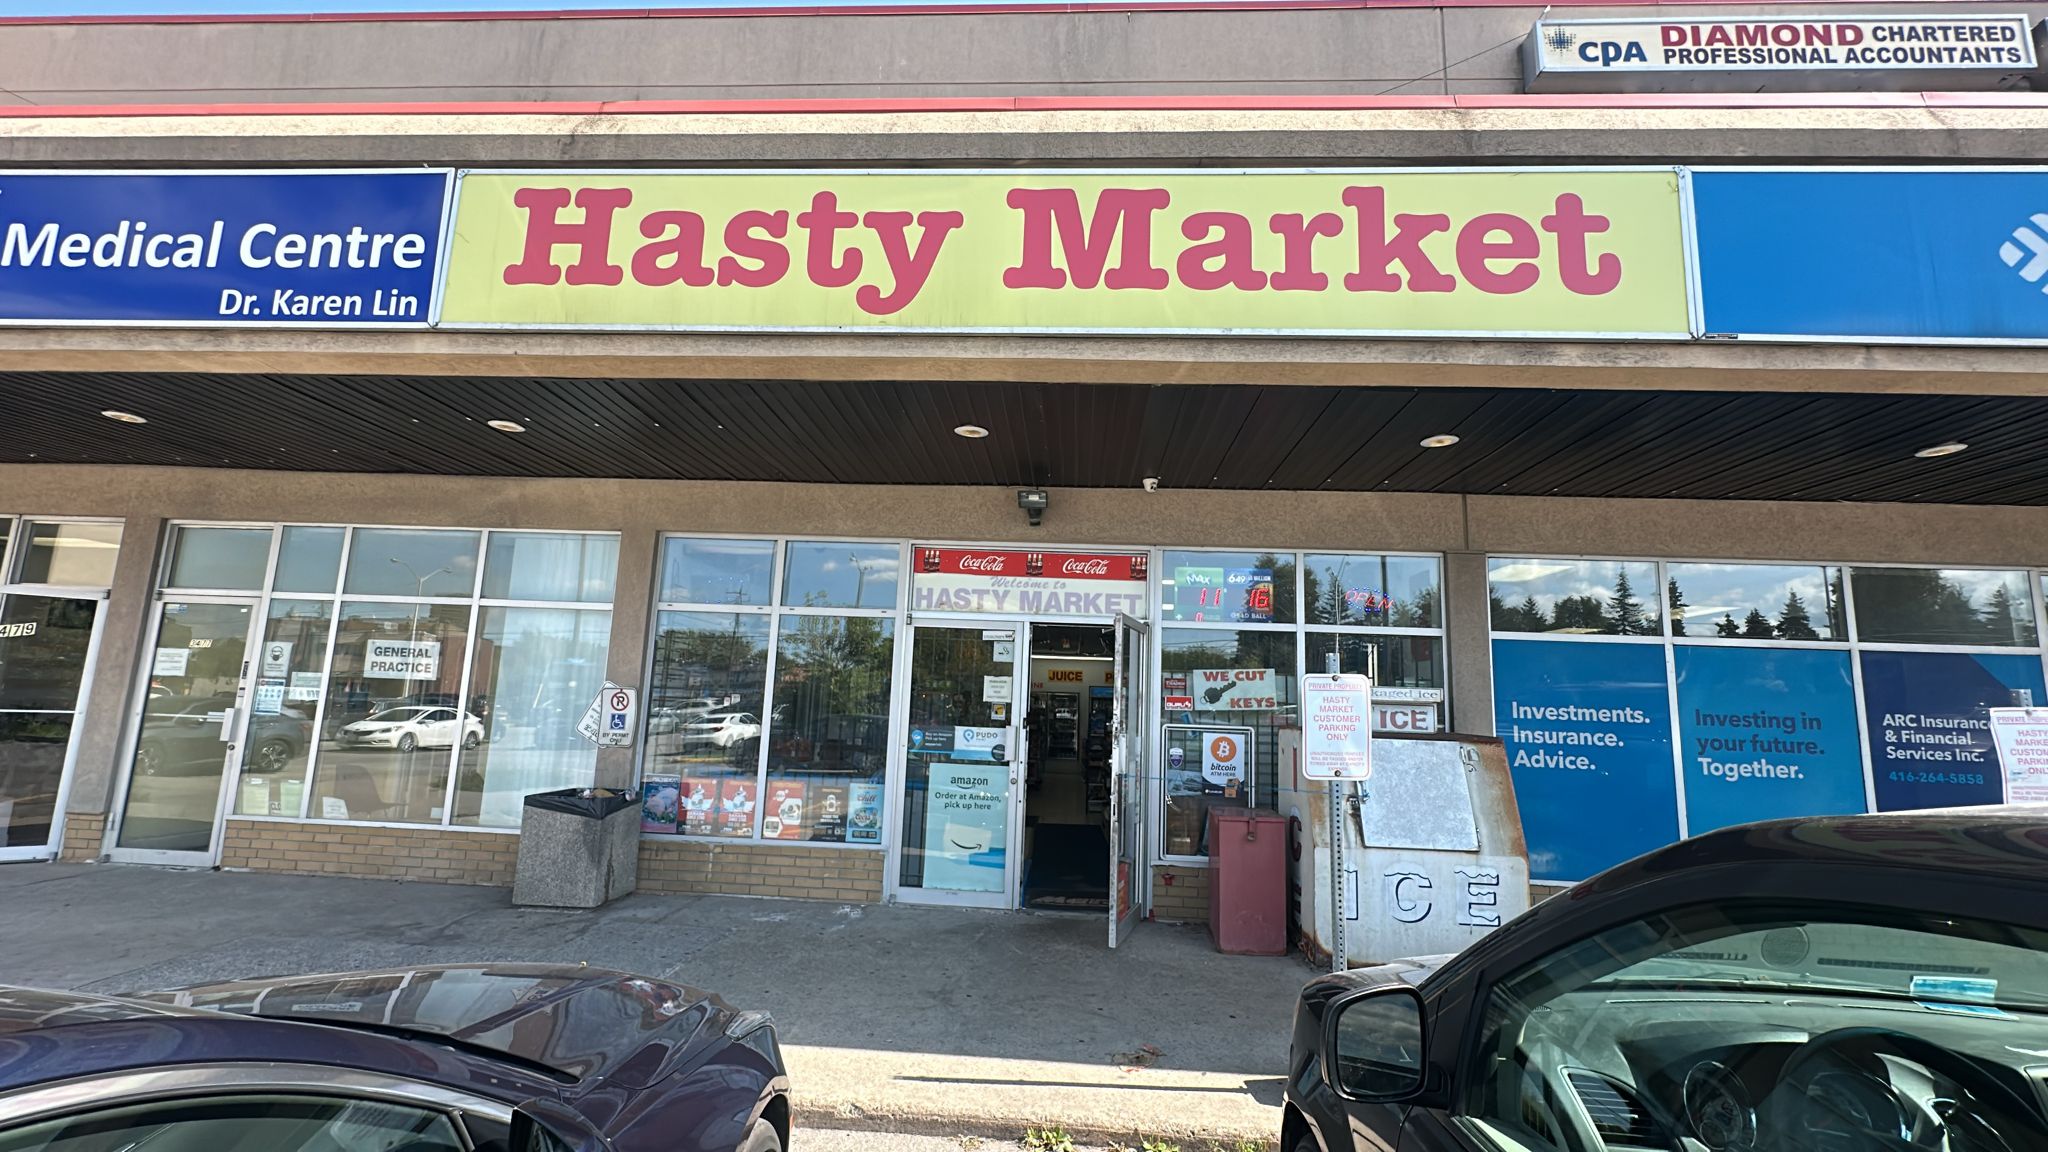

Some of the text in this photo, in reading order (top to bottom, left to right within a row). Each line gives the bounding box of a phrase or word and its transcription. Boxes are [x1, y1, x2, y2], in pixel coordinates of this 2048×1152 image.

[1661, 24, 2016, 46] DIAMOND CHARTERED
[1664, 46, 2022, 64] PROFESSIONAL ACCOUNTANTS
[1, 220, 425, 270] Medical Centre
[503, 185, 1621, 315] Hasty Market
[218, 289, 418, 317] Dr. Karen Lin
[990, 576, 1067, 590] Welcome to
[914, 586, 1143, 615] HASTY MARKET
[1249, 587, 1270, 608] 16
[374, 646, 432, 659] GENERAL
[370, 661, 432, 674] PRACTICE
[1048, 671, 1083, 681] JUICE
[1203, 670, 1266, 682] WE CUT
[1322, 696, 1350, 704] HASTY
[1418, 690, 1438, 699] ice
[1230, 697, 1275, 709] KEYS
[1319, 705, 1354, 713] MARKET
[1313, 715, 1361, 723] CUSTOMER
[1512, 701, 1650, 723] Investments.
[1379, 710, 1429, 730] ICE
[1695, 709, 1822, 734] Investing in
[1883, 714, 1917, 727] ARC
[976, 731, 998, 739] PUDO
[1319, 724, 1356, 732] PARKING
[1326, 733, 1348, 741] ONLY
[1513, 725, 1624, 747] Insurance.
[1885, 730, 1972, 745] & Financial
[1696, 734, 1825, 755] your future.
[1513, 750, 1596, 770] Advice.
[1886, 746, 1984, 762] Services Inc.
[1210, 763, 1237, 772] bitcoin
[1698, 757, 1804, 782] Together.
[950, 776, 988, 787] amazon
[1889, 771, 1984, 785] 416-264-5858
[935, 791, 957, 800] Order
[969, 793, 1001, 803] Amazon,
[944, 801, 960, 809] pick
[974, 802, 991, 810] here
